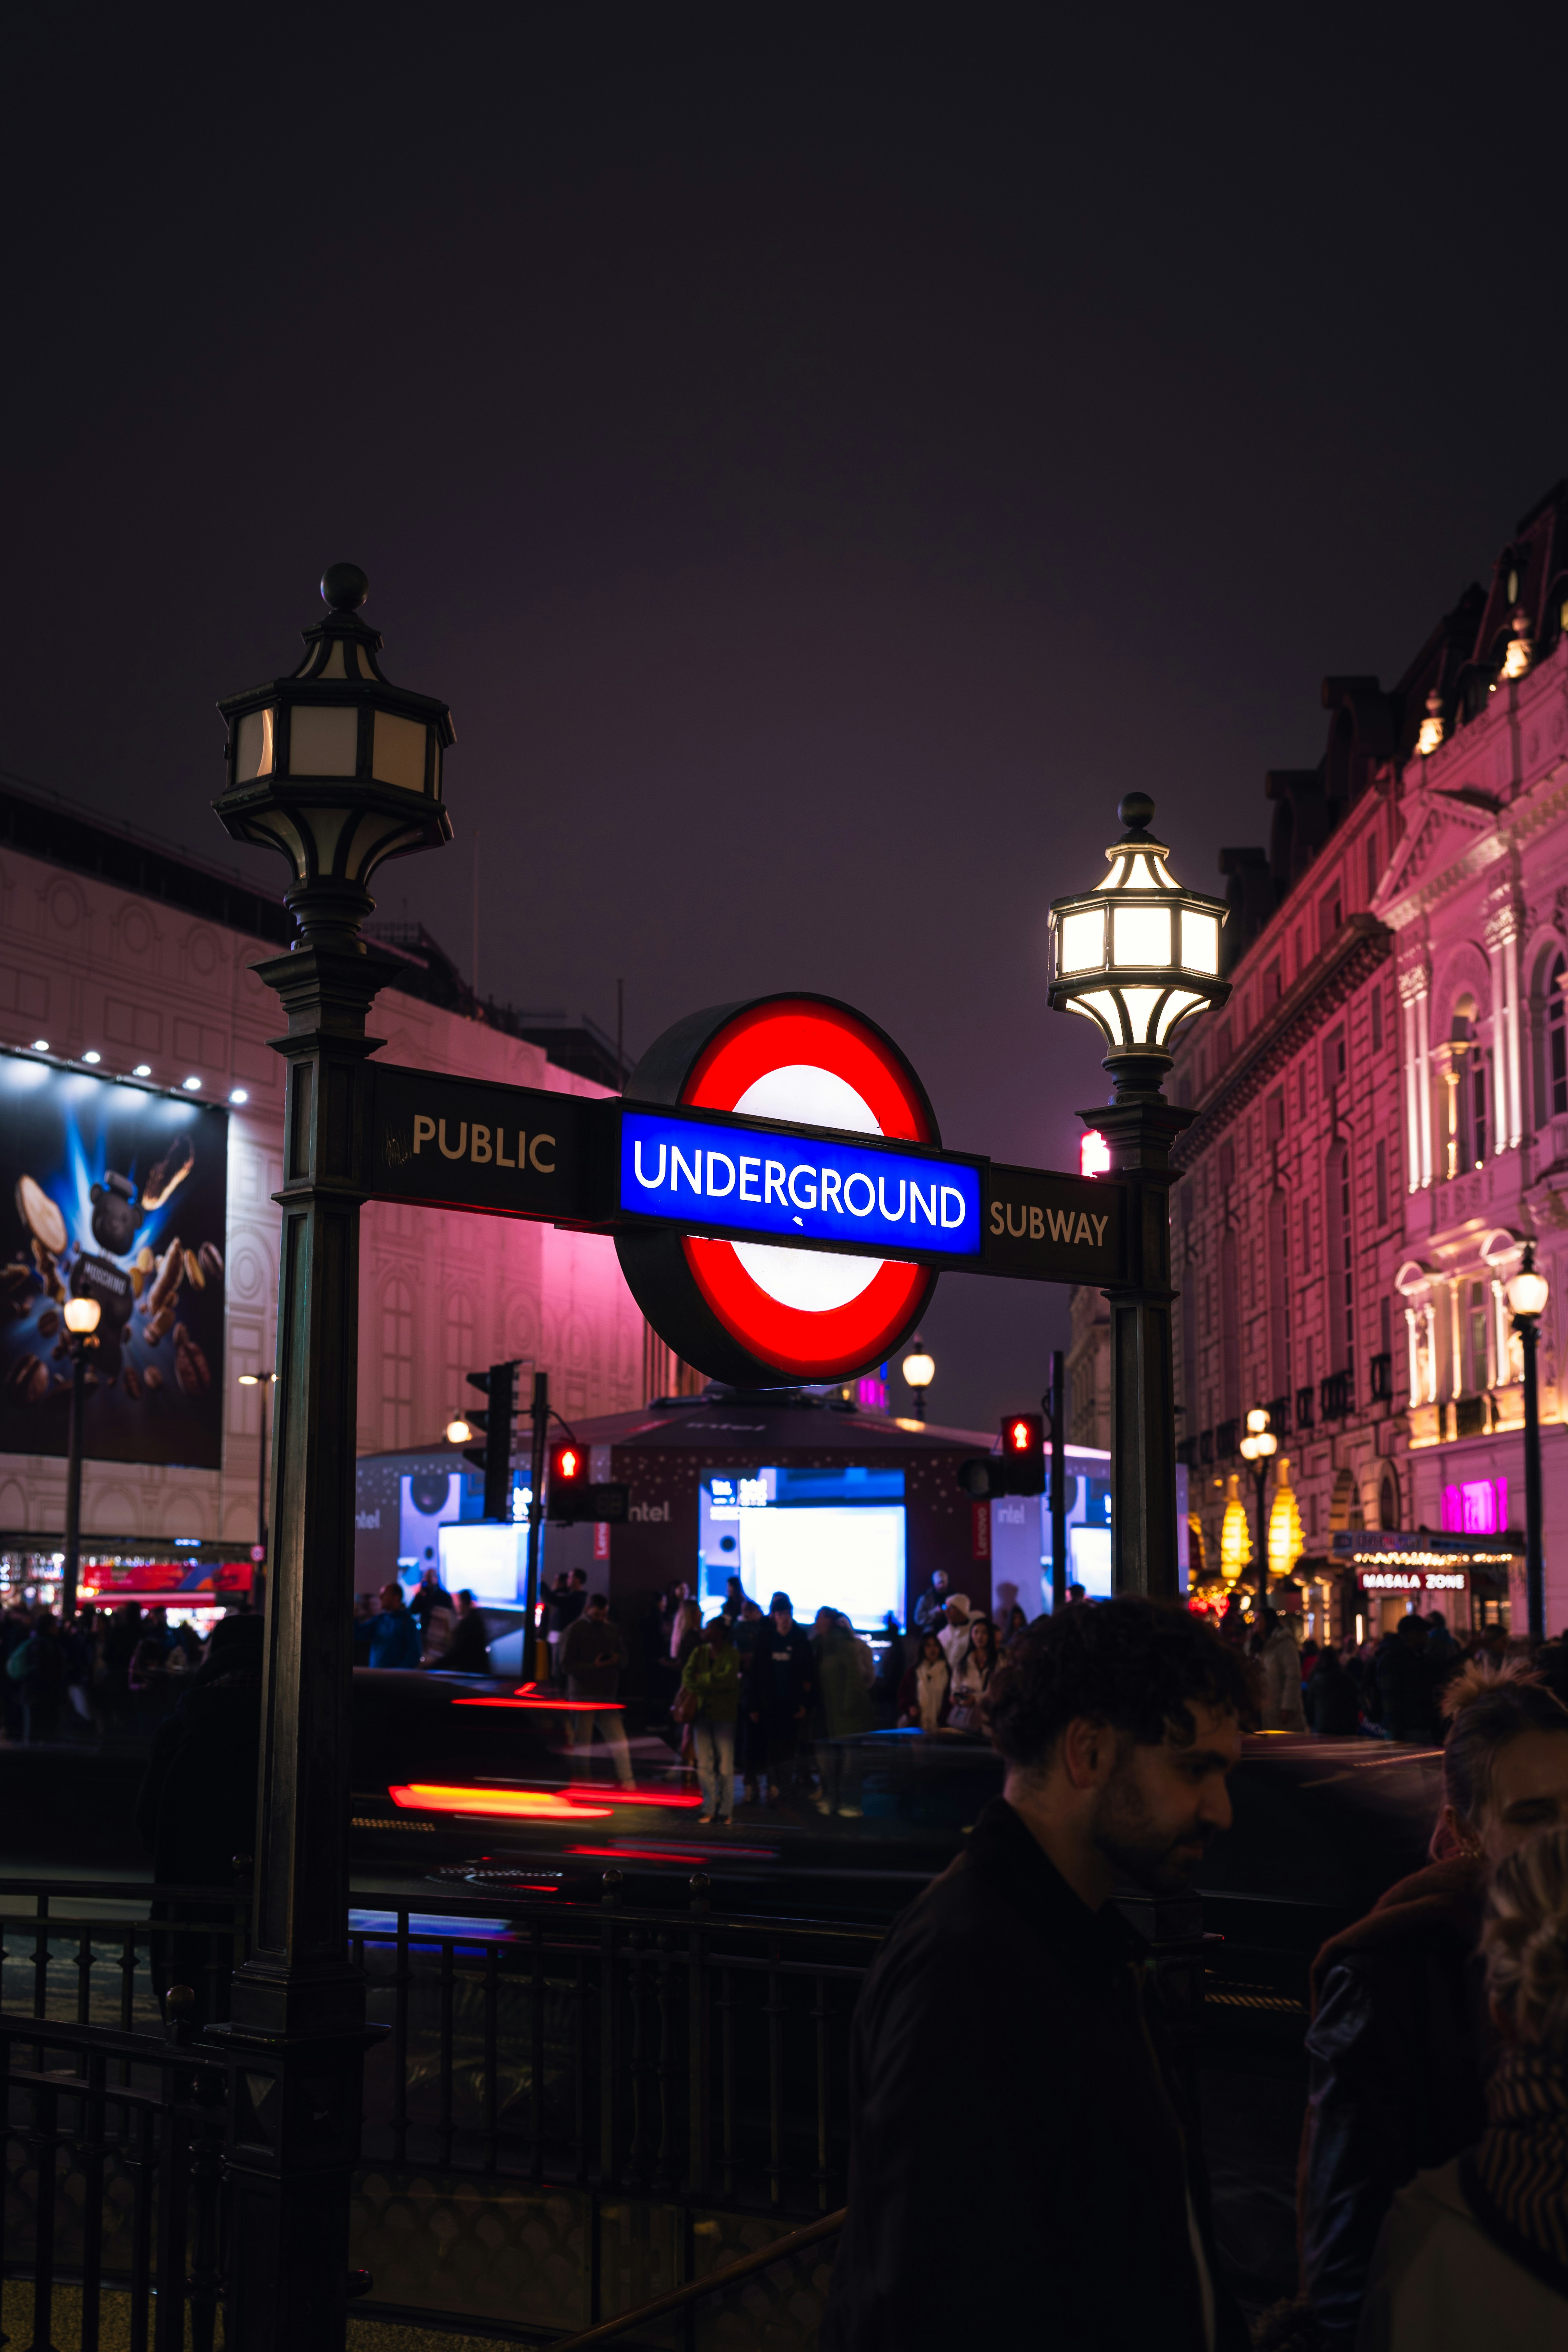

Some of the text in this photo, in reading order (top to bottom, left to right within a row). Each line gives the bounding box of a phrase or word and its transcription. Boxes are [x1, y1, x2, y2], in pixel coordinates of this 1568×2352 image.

[413, 1115, 556, 1173] PUBLIC
[634, 1141, 966, 1228] UNDERGROUND
[990, 1201, 1108, 1246] SUBWAY
[629, 1501, 670, 1522] ntel
[1363, 1573, 1465, 1589] MASALA ZONE
